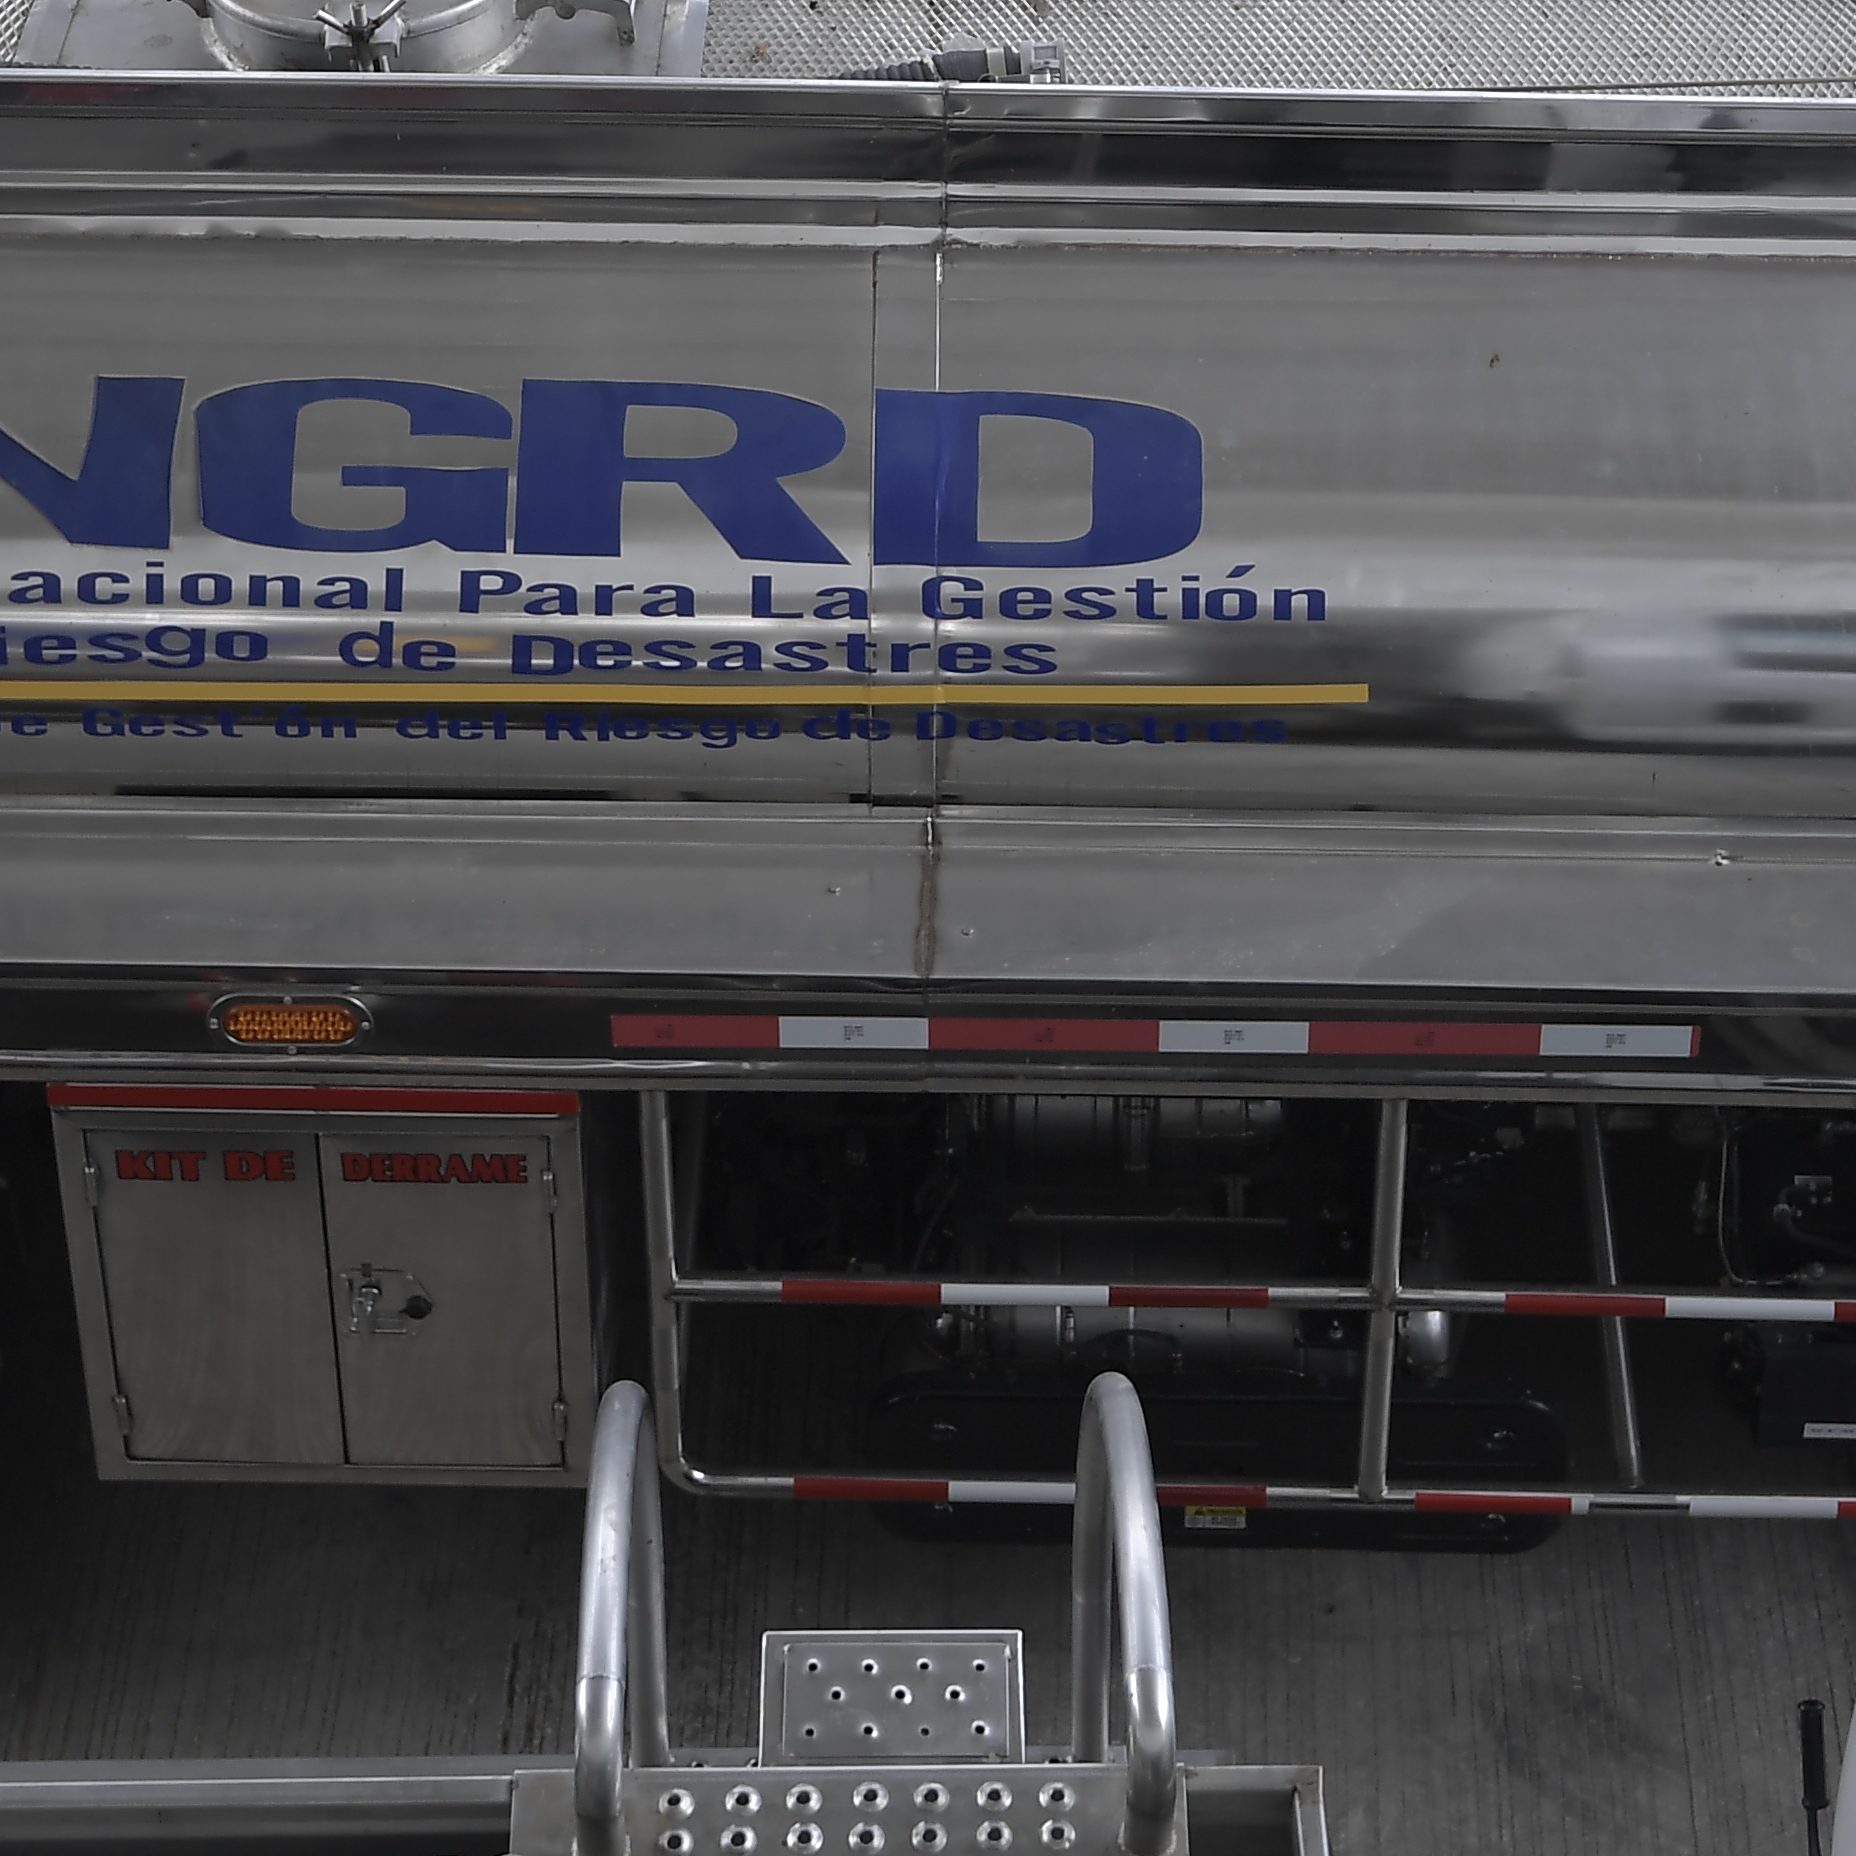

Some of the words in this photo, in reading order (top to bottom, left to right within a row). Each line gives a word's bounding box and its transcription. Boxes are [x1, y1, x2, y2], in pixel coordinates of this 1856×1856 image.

[459, 569, 695, 619] Para
[751, 575, 868, 620] La
[921, 564, 1325, 622] Gestión
[339, 621, 456, 673] de
[511, 631, 1058, 677] Desastres
[396, 709, 507, 740] del
[802, 710, 892, 742] de
[915, 710, 1288, 745] Desastres
[117, 1150, 206, 1181] KIT
[224, 1150, 296, 1182] DE
[340, 1153, 528, 1184] DERRAME
